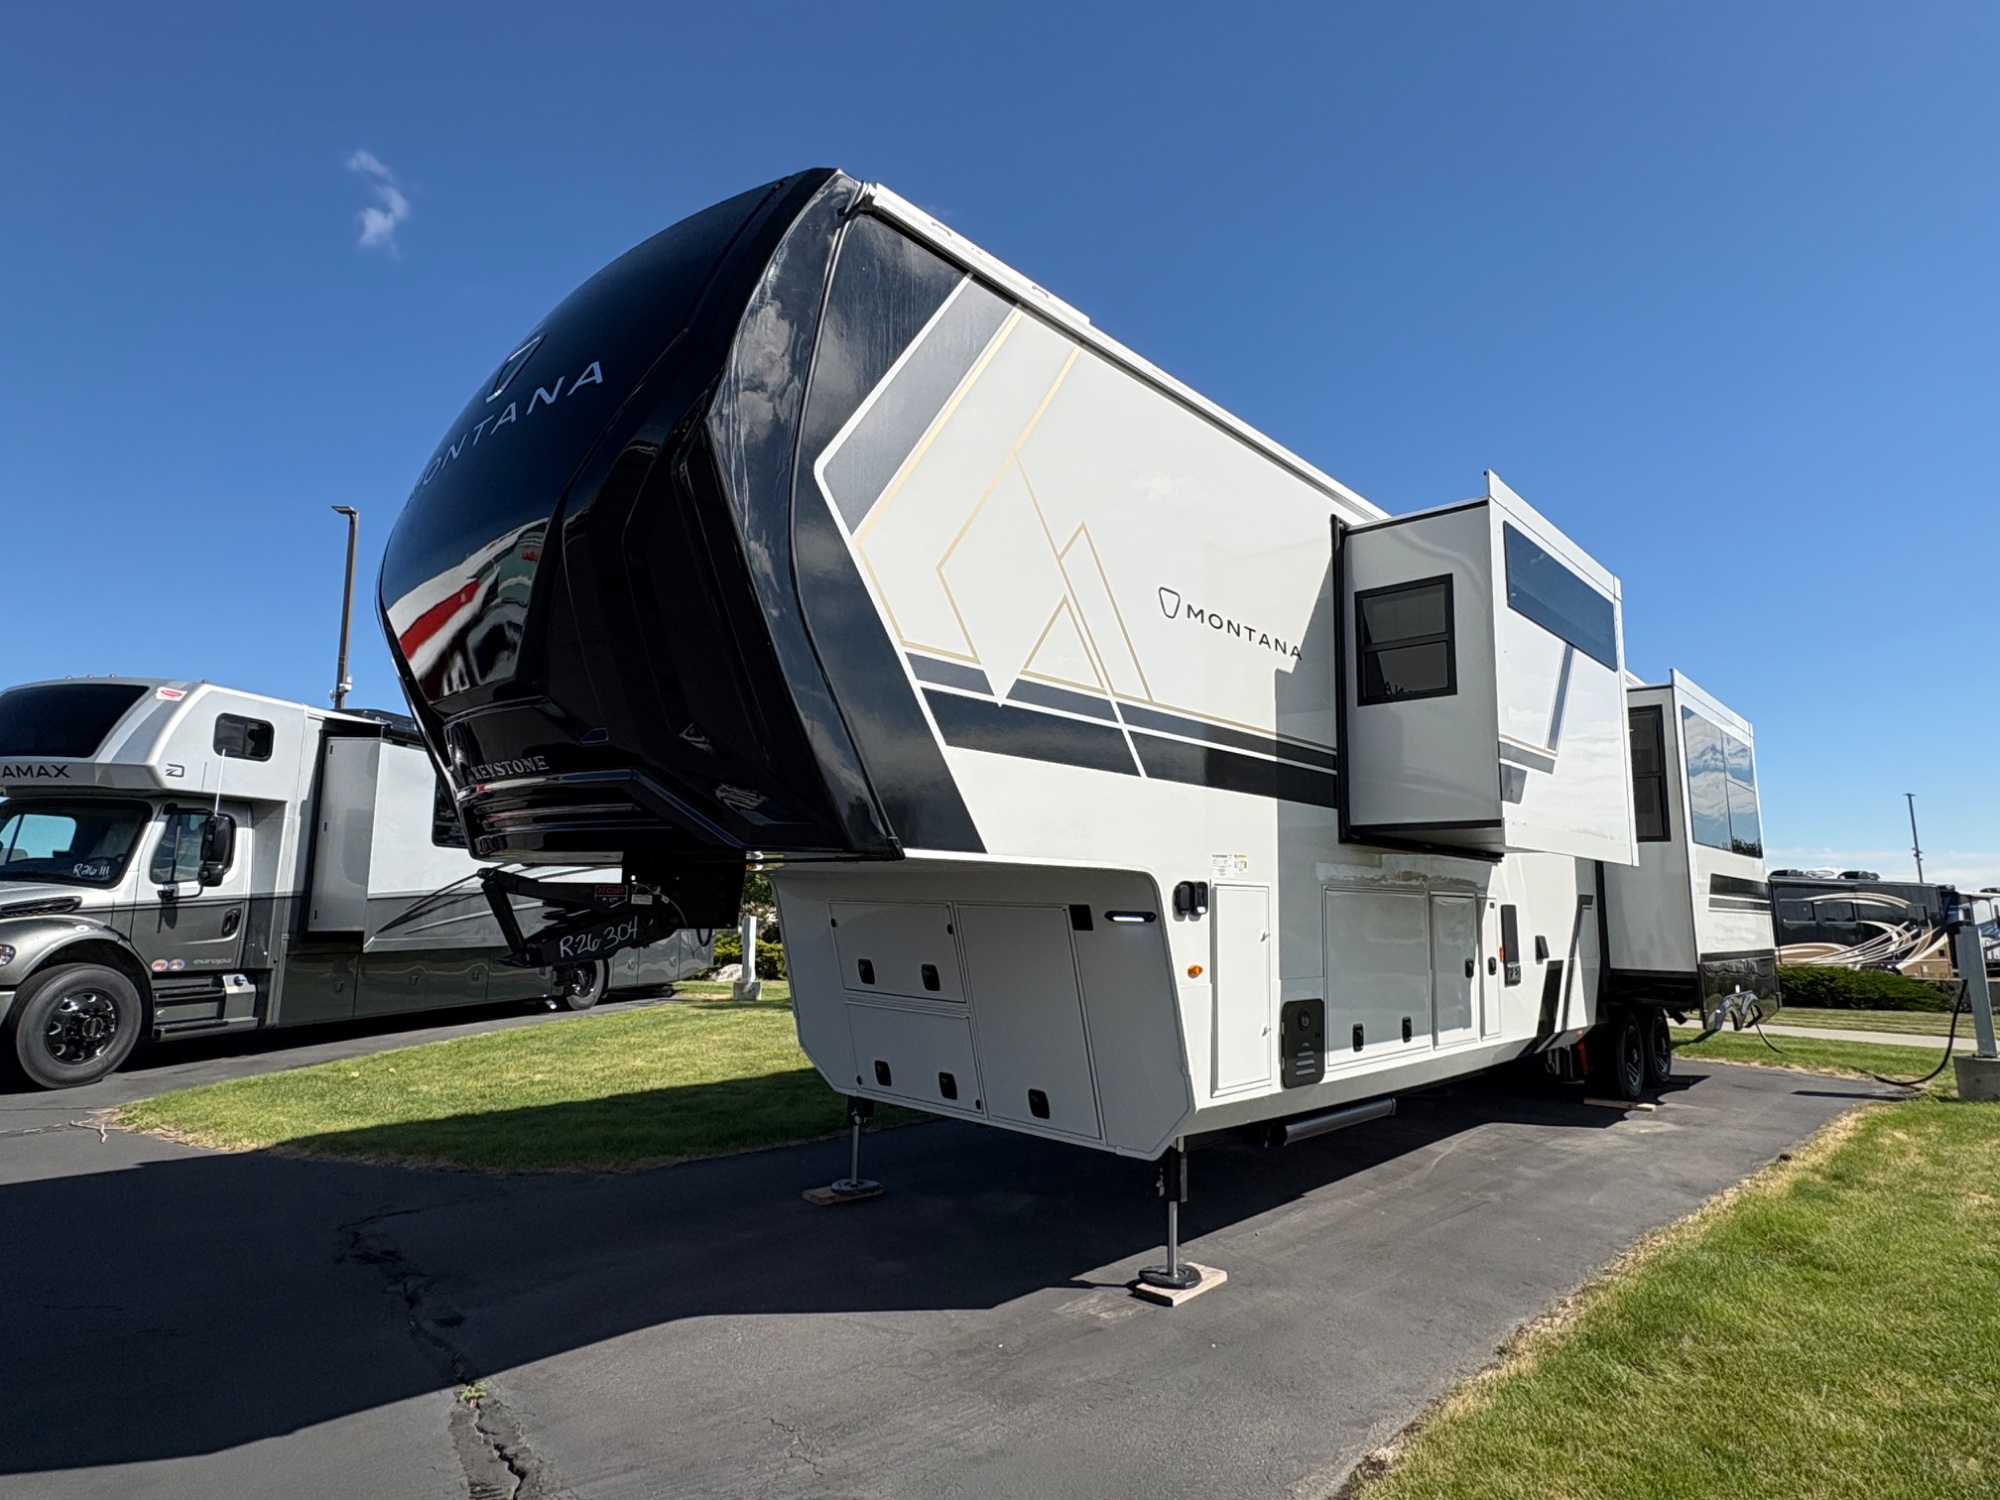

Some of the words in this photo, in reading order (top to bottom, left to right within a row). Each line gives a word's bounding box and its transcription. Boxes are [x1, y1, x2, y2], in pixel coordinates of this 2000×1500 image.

[1186, 603, 1303, 661] MONTANA
[1, 764, 71, 778] AMAX
[470, 755, 550, 780] KEYSTONE
[603, 915, 638, 950] 304
